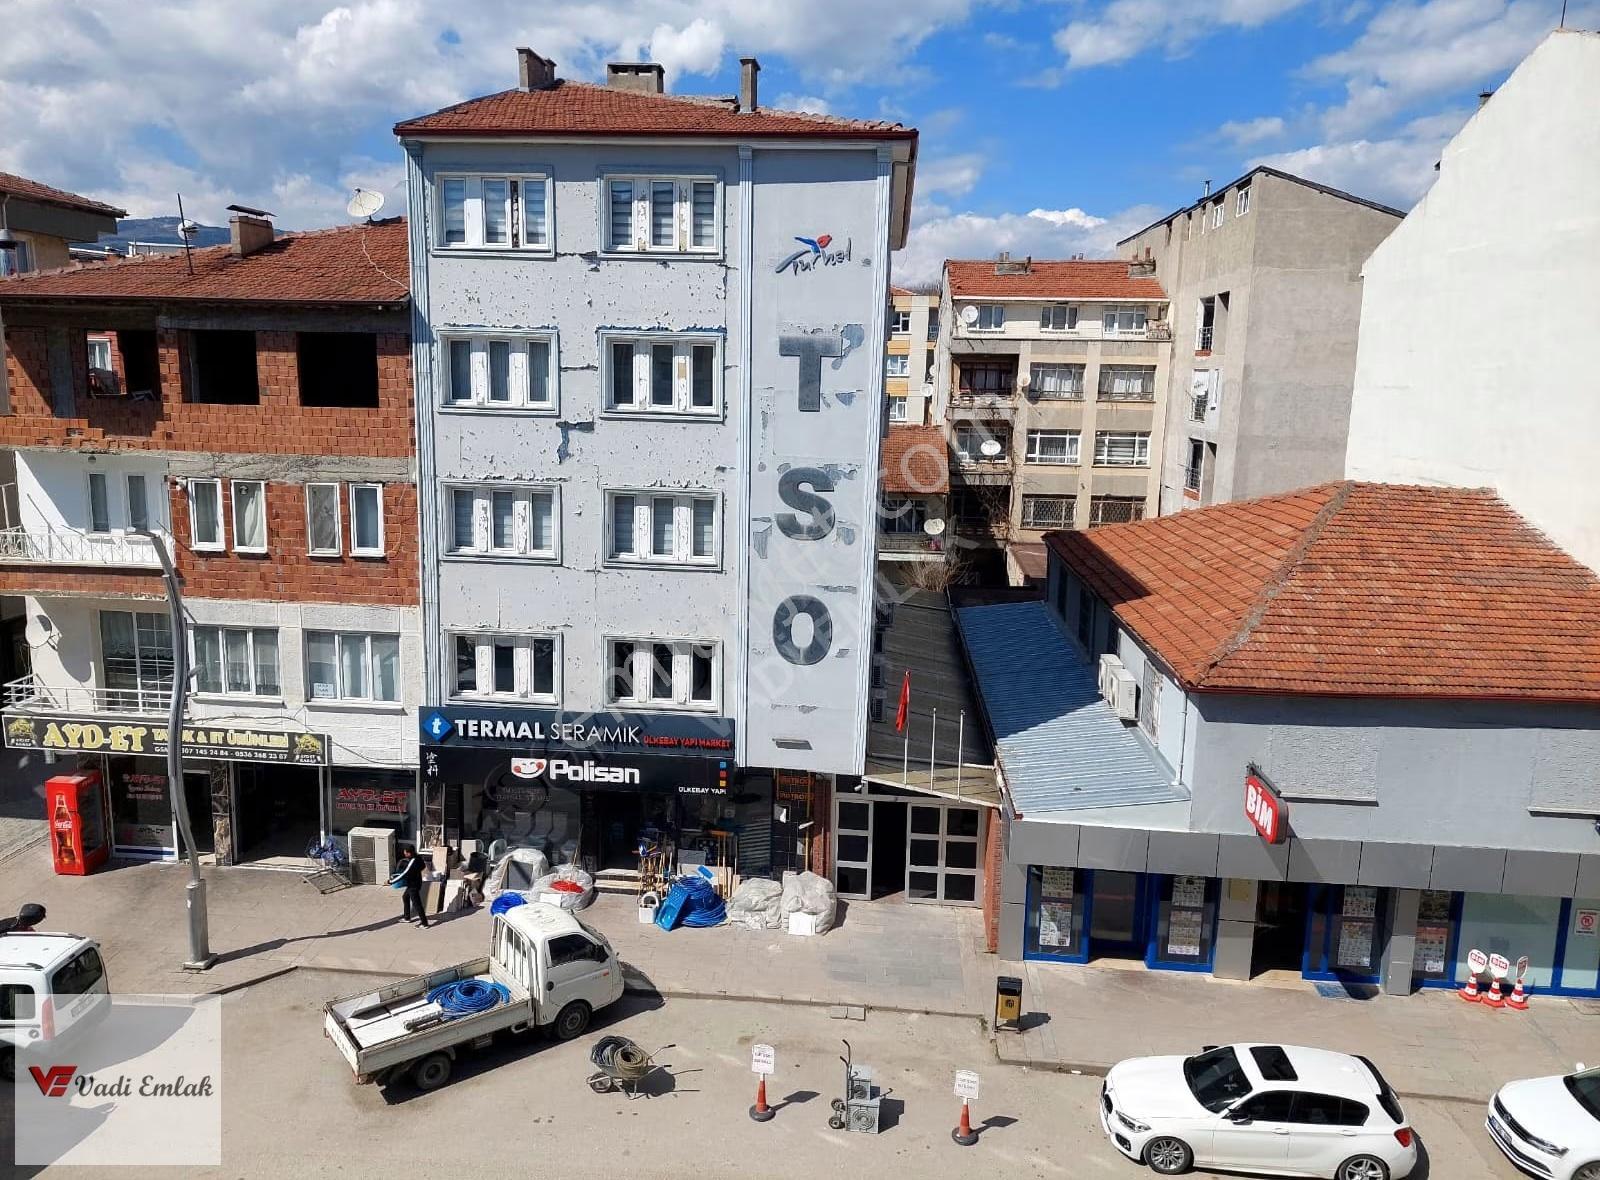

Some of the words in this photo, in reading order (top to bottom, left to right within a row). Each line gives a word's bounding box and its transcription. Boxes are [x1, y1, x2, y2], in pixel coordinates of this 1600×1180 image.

[43, 722, 147, 752] AYD-ET
[196, 731, 208, 743] &
[454, 719, 545, 739] TERMAL
[679, 736, 698, 746] YAPI
[698, 737, 732, 749] MARKET
[549, 759, 640, 784] Polisan
[1246, 784, 1273, 836] BİM
